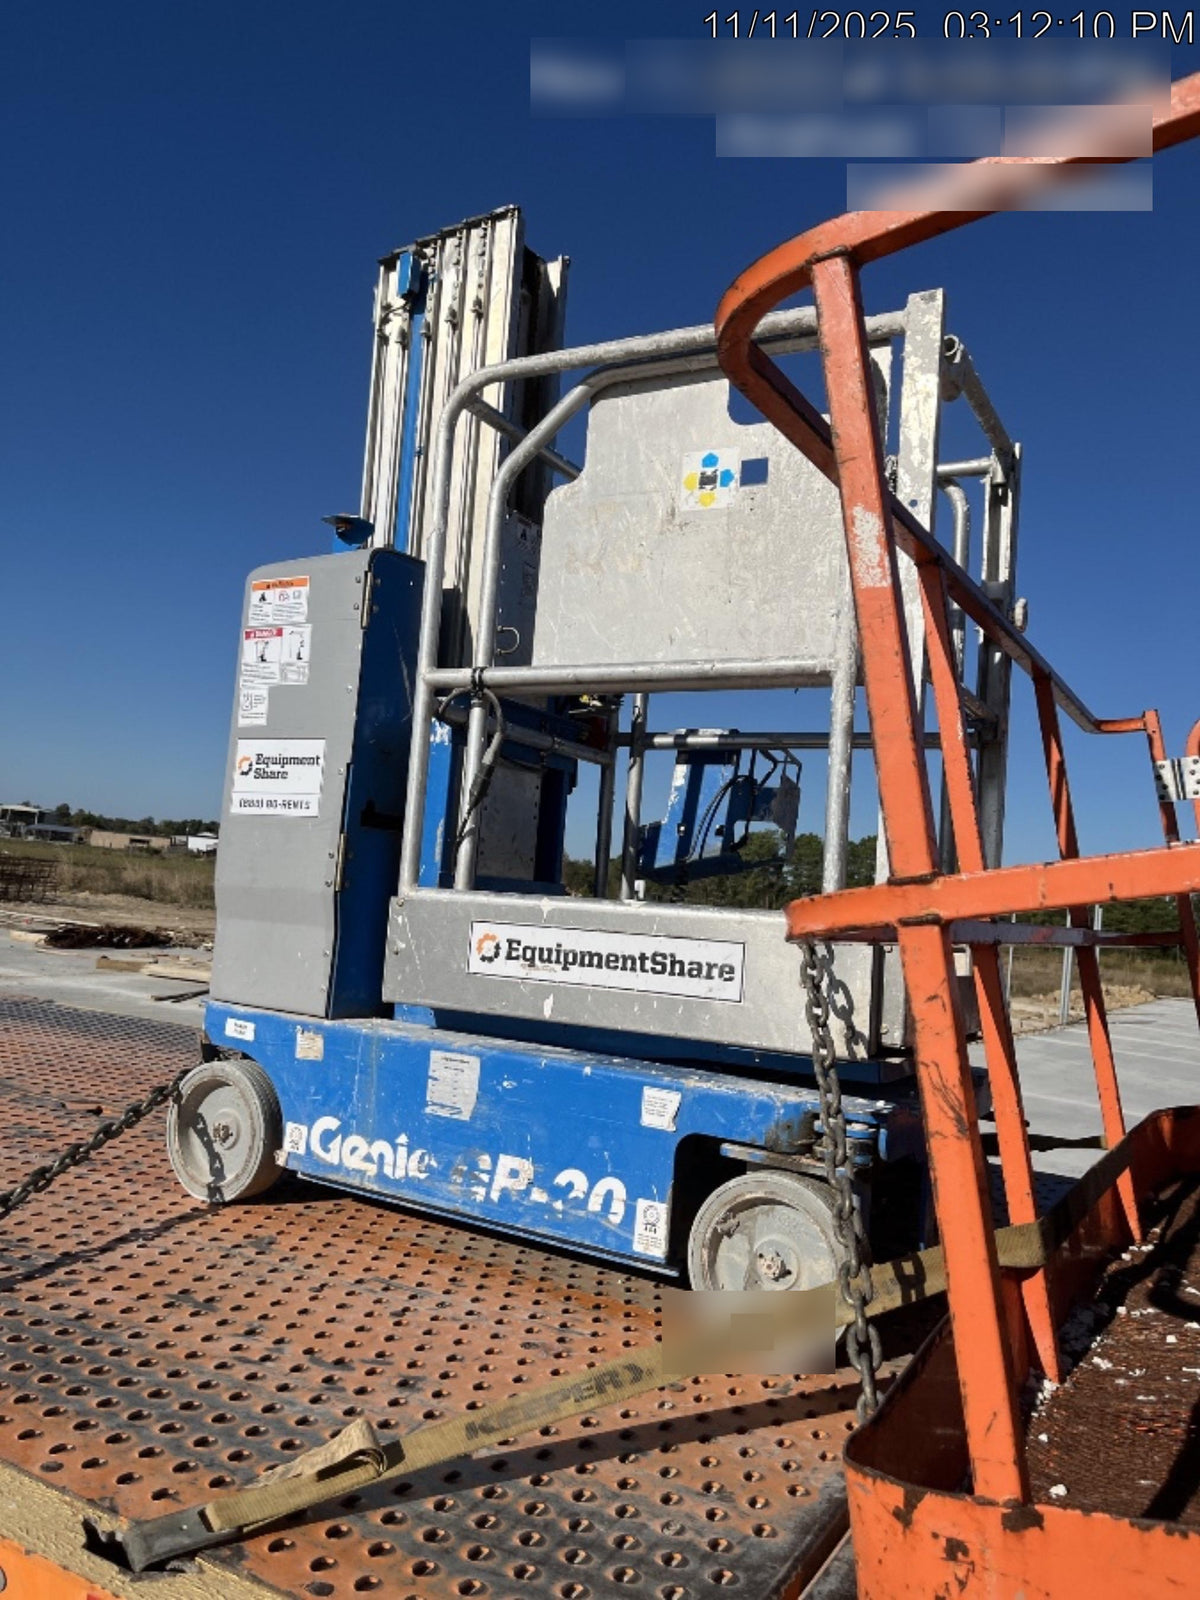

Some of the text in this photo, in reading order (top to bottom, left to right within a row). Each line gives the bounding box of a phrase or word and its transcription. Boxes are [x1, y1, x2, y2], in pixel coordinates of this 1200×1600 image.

[253, 767, 289, 779] Share
[255, 753, 320, 768] Equipment
[504, 938, 736, 982] EquipmentShare
[310, 1115, 437, 1180] Genie
